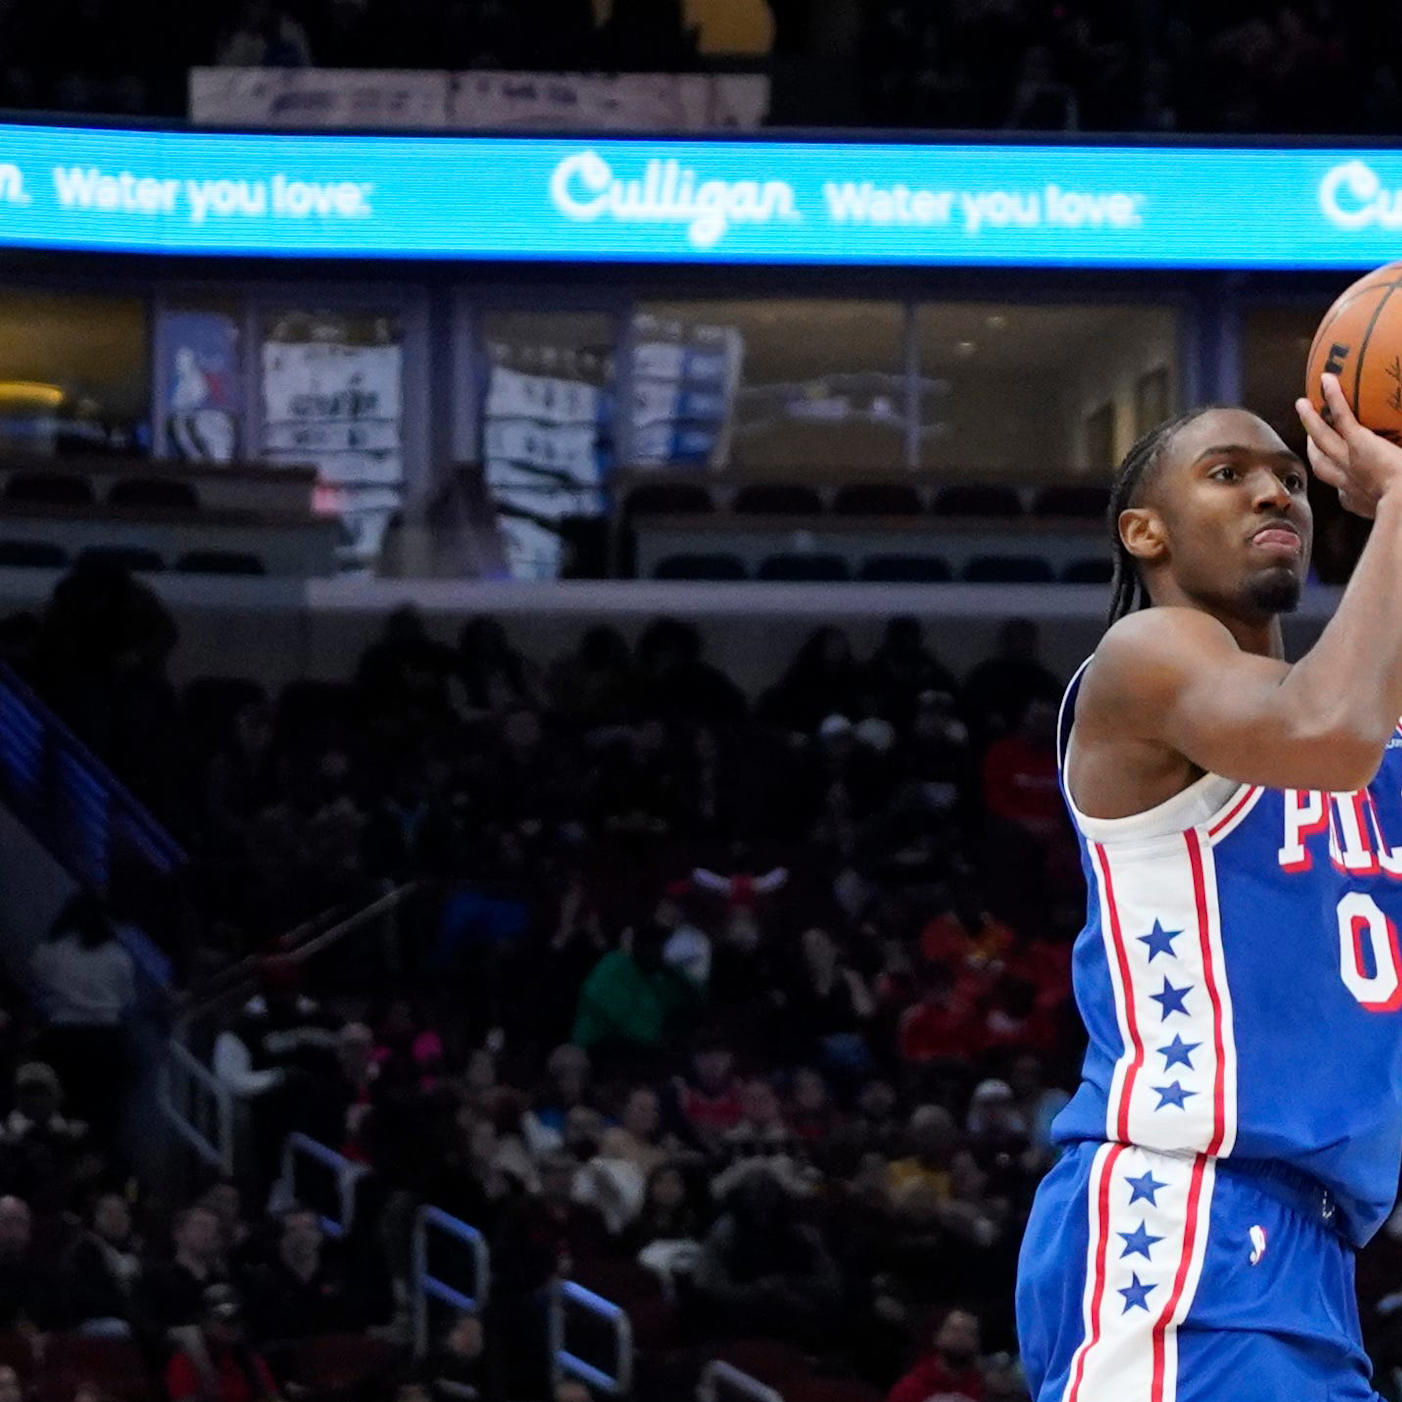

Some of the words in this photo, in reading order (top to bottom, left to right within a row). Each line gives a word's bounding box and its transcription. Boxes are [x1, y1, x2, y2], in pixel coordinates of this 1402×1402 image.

[53, 166, 177, 215] Water
[186, 175, 266, 223] you
[823, 180, 953, 227] Water
[961, 187, 1039, 235] you
